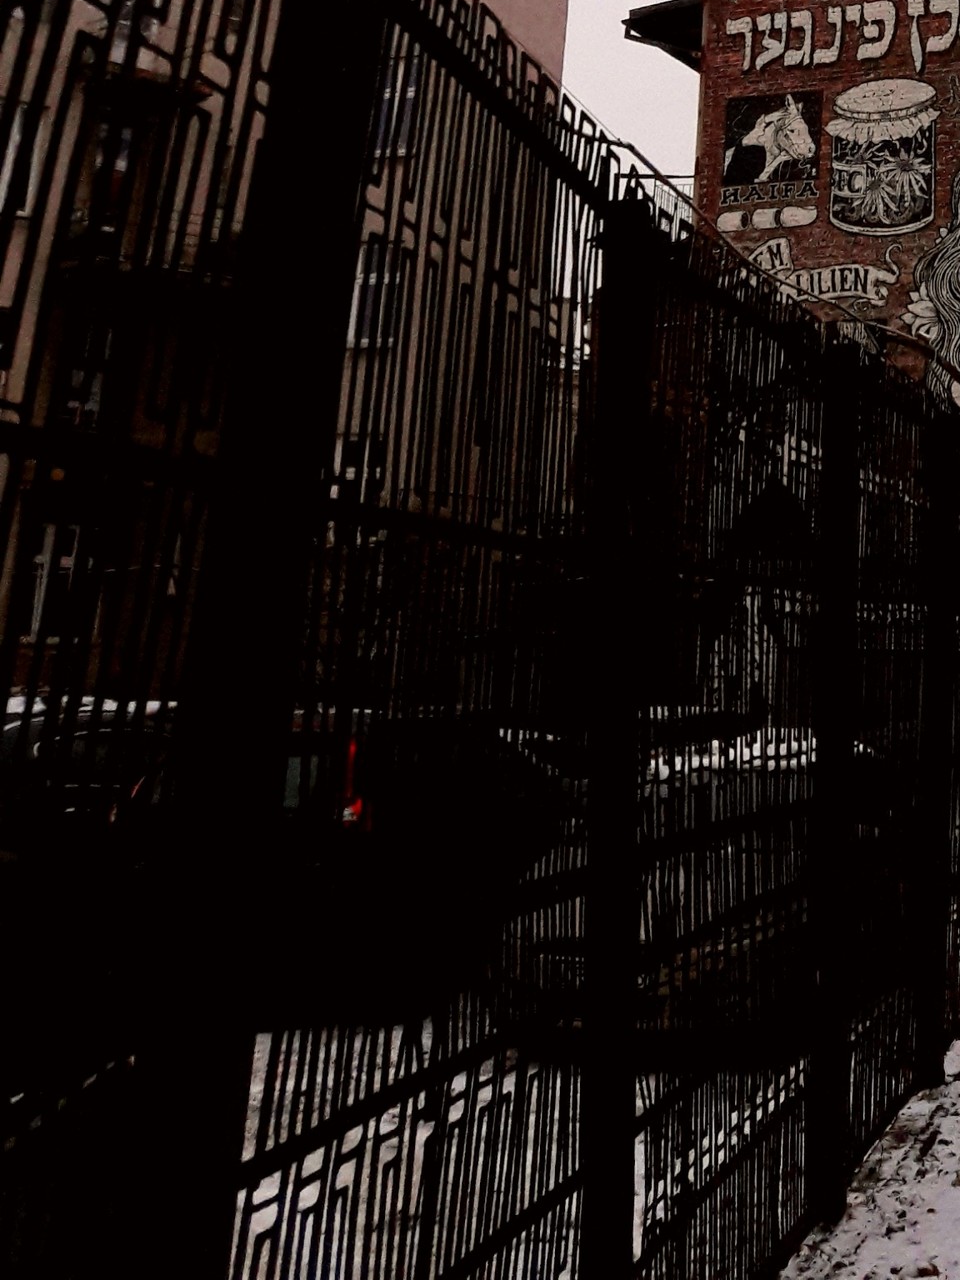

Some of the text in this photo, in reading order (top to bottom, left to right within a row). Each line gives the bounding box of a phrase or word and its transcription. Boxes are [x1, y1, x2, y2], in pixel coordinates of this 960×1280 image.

[725, 0, 897, 71] פינגער
[720, 180, 819, 206] HAIFA
[795, 267, 870, 296] LILIEN
